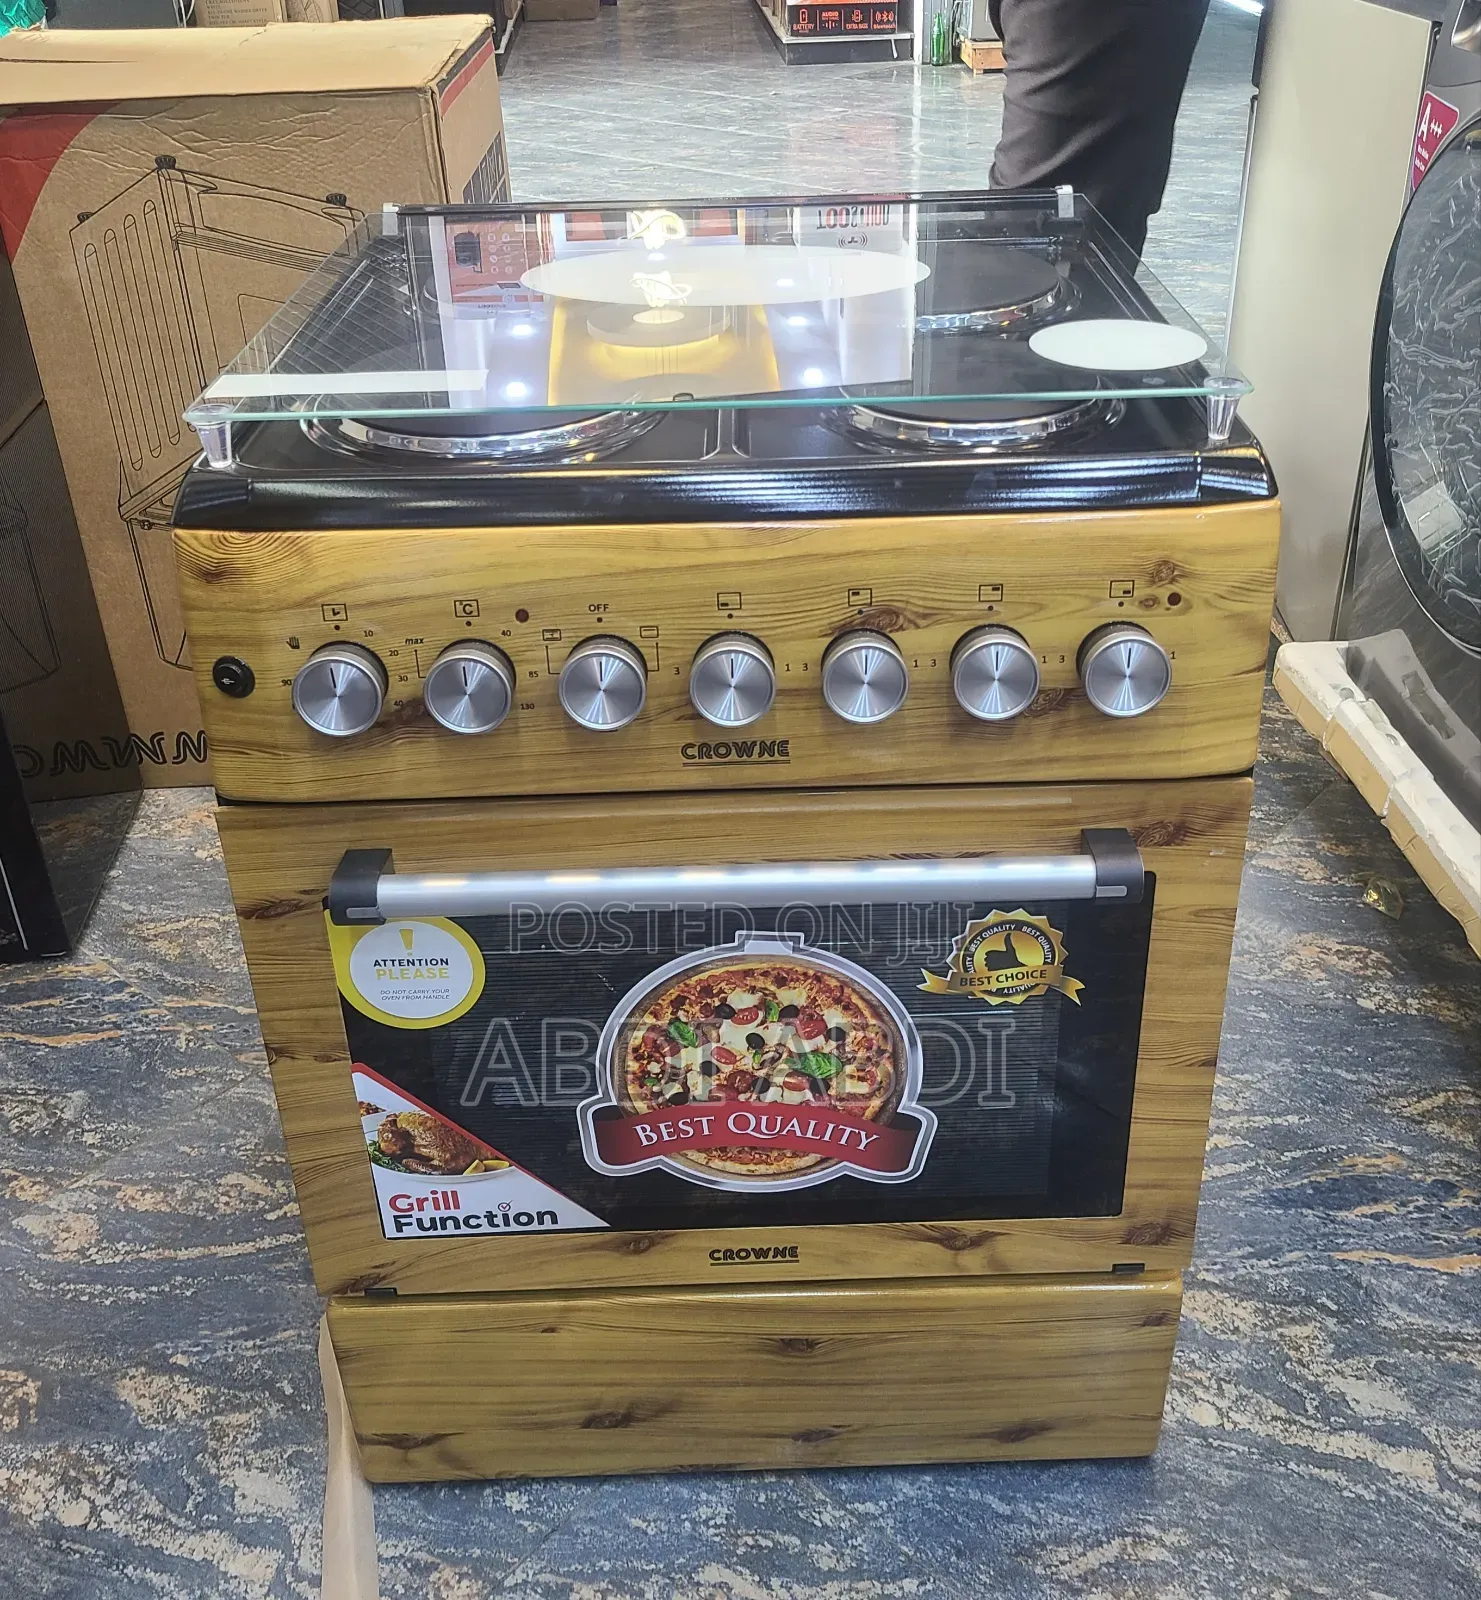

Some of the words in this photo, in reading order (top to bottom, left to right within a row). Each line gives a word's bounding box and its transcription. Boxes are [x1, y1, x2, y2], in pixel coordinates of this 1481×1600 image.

[792, 23, 814, 31] BATTERY
[588, 603, 609, 613] OFF
[363, 630, 374, 638] 10
[500, 629, 512, 637] 40
[405, 637, 425, 645] max
[1041, 655, 1047, 664] 1
[1059, 655, 1066, 663] 3
[1170, 651, 1176, 660] 1
[913, 659, 919, 668] 1
[930, 658, 937, 667] 3
[673, 666, 680, 675] 3
[785, 664, 791, 672] 1
[802, 663, 809, 672] 3
[528, 670, 539, 678] 85
[281, 679, 292, 687] 90
[398, 675, 408, 683] 30
[393, 700, 404, 708] 40
[520, 702, 535, 710] 130
[681, 740, 790, 760] CROWNE
[969, 936, 983, 952] BEST
[982, 924, 1016, 938] QUALITY
[1021, 926, 1040, 938] BEST
[1038, 936, 1052, 963] QUALITY
[373, 958, 449, 968] ATTENTION
[376, 967, 450, 980] PLEASE
[960, 975, 992, 987] BEST
[995, 969, 1047, 983] CHOICE
[633, 1116, 714, 1148] BEST
[727, 1111, 882, 1152] QUALITY
[389, 1190, 461, 1213] Grill
[393, 1209, 559, 1233] Function
[709, 1246, 799, 1261] CROWNE
